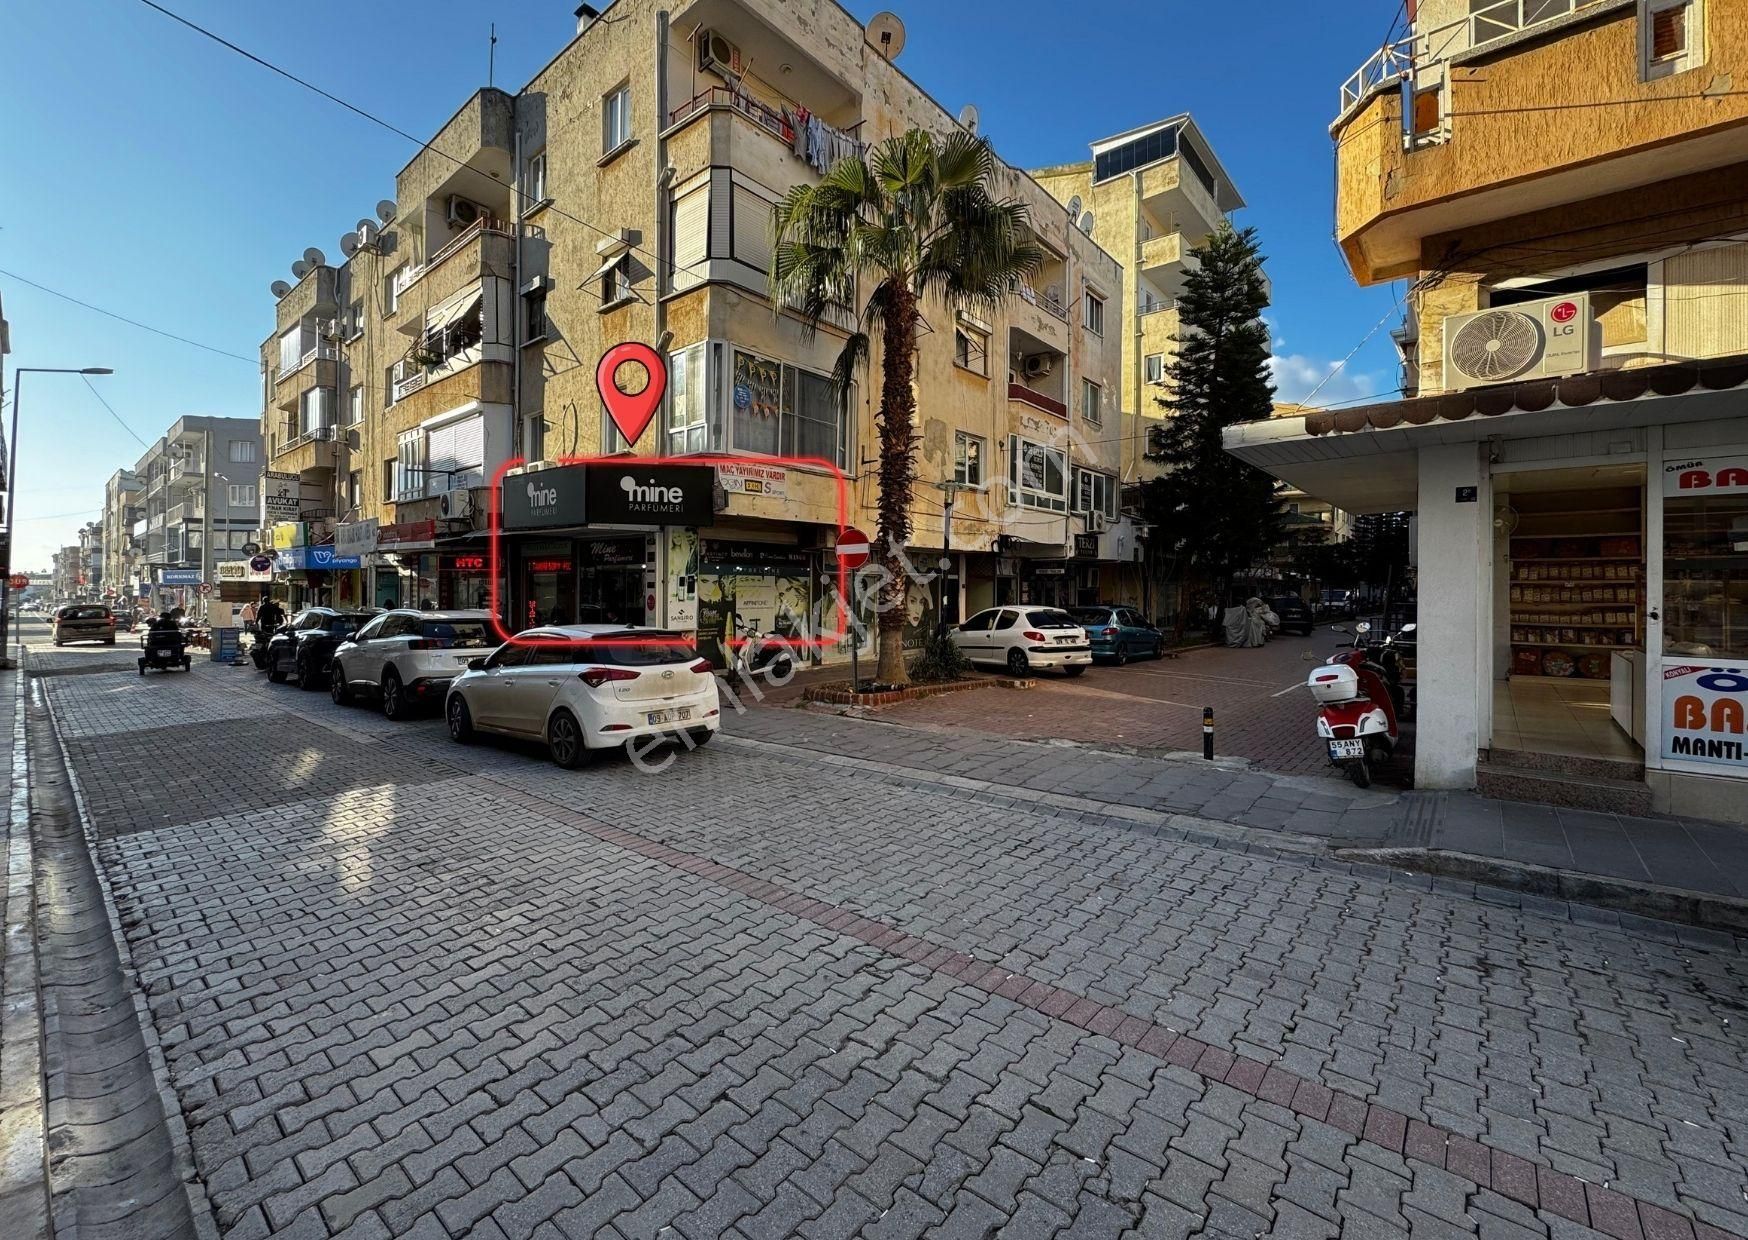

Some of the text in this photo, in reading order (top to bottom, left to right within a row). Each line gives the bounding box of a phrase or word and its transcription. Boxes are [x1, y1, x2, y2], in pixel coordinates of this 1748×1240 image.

[1553, 324, 1574, 337] LG
[527, 482, 557, 507] mine
[620, 476, 684, 503] mine
[267, 497, 298, 506] AVUKAT
[1665, 666, 1692, 678] KONYALI
[1673, 694, 1748, 735] BA
[1331, 740, 1361, 749] 55 ANY
[1345, 747, 1363, 756] 872
